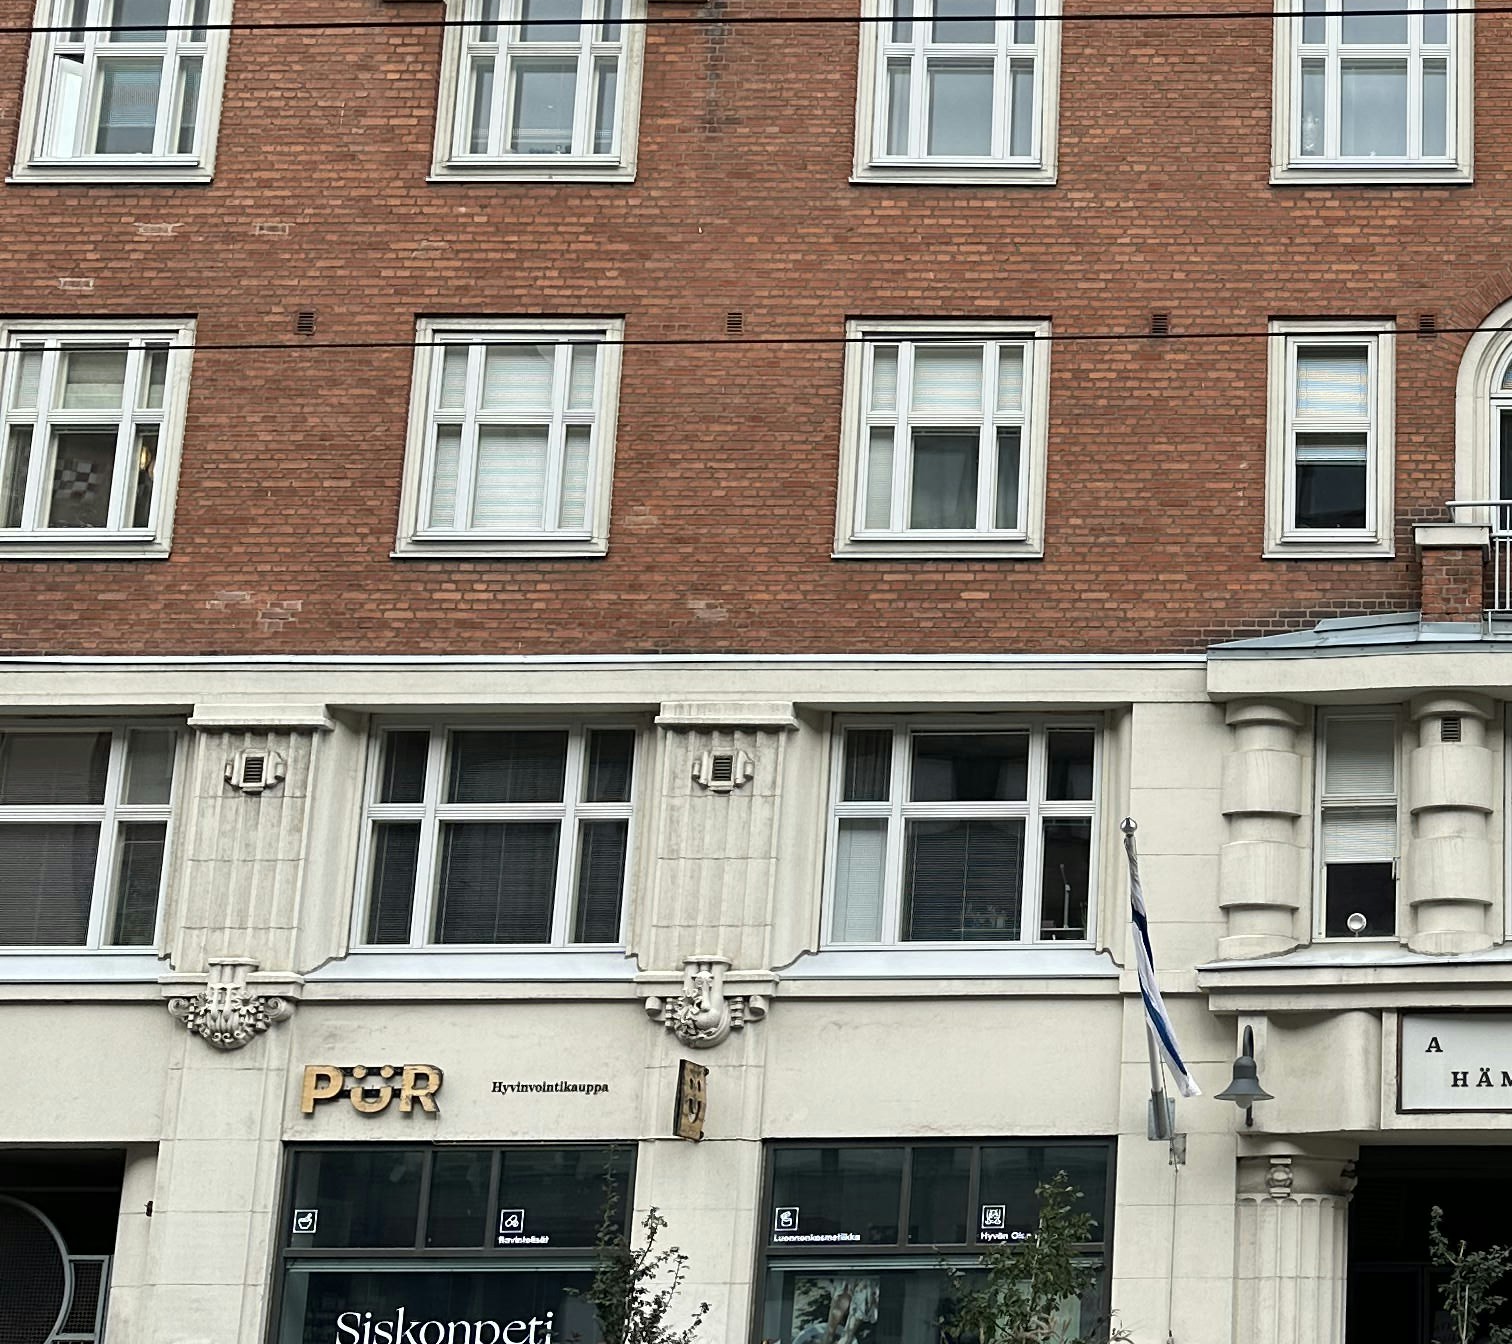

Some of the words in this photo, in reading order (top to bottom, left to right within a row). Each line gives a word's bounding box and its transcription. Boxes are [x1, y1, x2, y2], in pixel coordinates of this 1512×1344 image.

[1425, 1036, 1444, 1053] A
[301, 1063, 444, 1114] PÜR
[491, 1080, 610, 1096] Hyvinvointikauppa
[980, 1231, 1009, 1242] Hyvän
